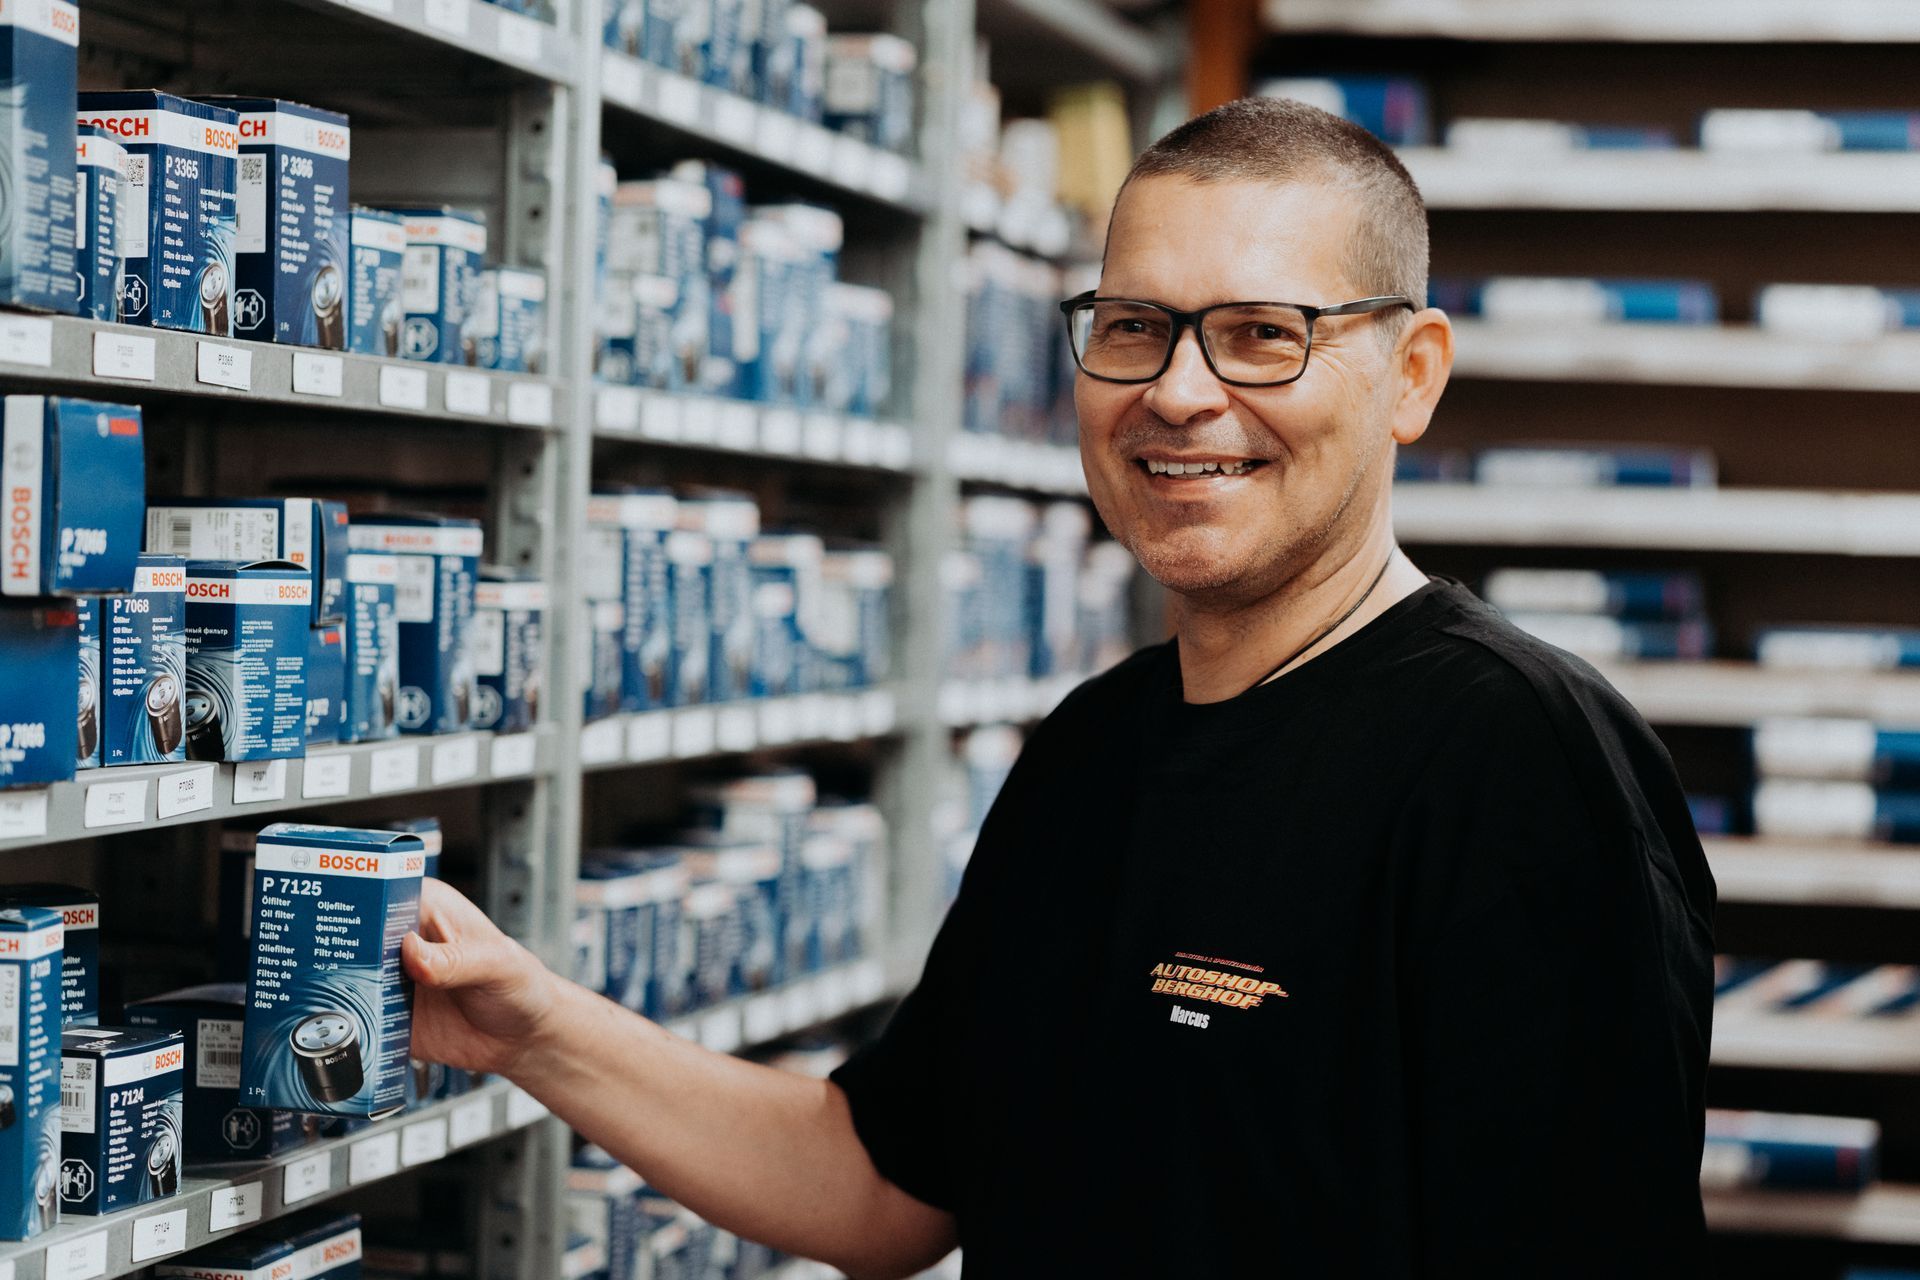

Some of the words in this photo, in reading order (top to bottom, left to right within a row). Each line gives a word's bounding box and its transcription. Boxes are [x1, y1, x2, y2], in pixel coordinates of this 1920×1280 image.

[205, 127, 239, 150] BOSCH
[165, 154, 172, 174] P
[174, 156, 199, 180] 3365
[281, 153, 289, 173] P
[11, 487, 32, 580] BOSCH
[152, 572, 183, 587] BOSCH
[186, 583, 229, 598] OSCH
[278, 586, 308, 599] BOSCH
[113, 599, 122, 614] P
[124, 599, 149, 613] 7068
[319, 854, 379, 873] BOSCH
[262, 877, 275, 893] P
[280, 878, 323, 897] 7125
[261, 895, 292, 908] Ölfilter
[317, 900, 356, 912] Oljefilter
[62, 909, 95, 925] OSCH
[261, 909, 273, 919] Oil
[275, 909, 296, 921] filter
[260, 921, 282, 933] Filtre
[259, 930, 280, 941] huile
[331, 936, 360, 948] filtresi
[258, 943, 296, 956] Oliefilter
[314, 948, 332, 958] Filtr
[333, 949, 355, 961] oleju
[257, 956, 280, 967] Filtro
[281, 957, 298, 968] olio
[256, 968, 279, 980] Filtro
[280, 970, 292, 981] de
[1150, 962, 1283, 997] AUTOSHOP
[255, 979, 281, 989] aceite
[255, 990, 278, 1002] Filtro
[279, 991, 290, 1002] de
[1151, 978, 1263, 1010] BERGHOF
[254, 999, 273, 1009] óleo
[1170, 1005, 1210, 1029] Marcus
[155, 1050, 181, 1070] BOSCH
[110, 1092, 119, 1109] P
[120, 1086, 145, 1107] 7124
[248, 1087, 254, 1095] 1
[255, 1087, 266, 1096] Pc
